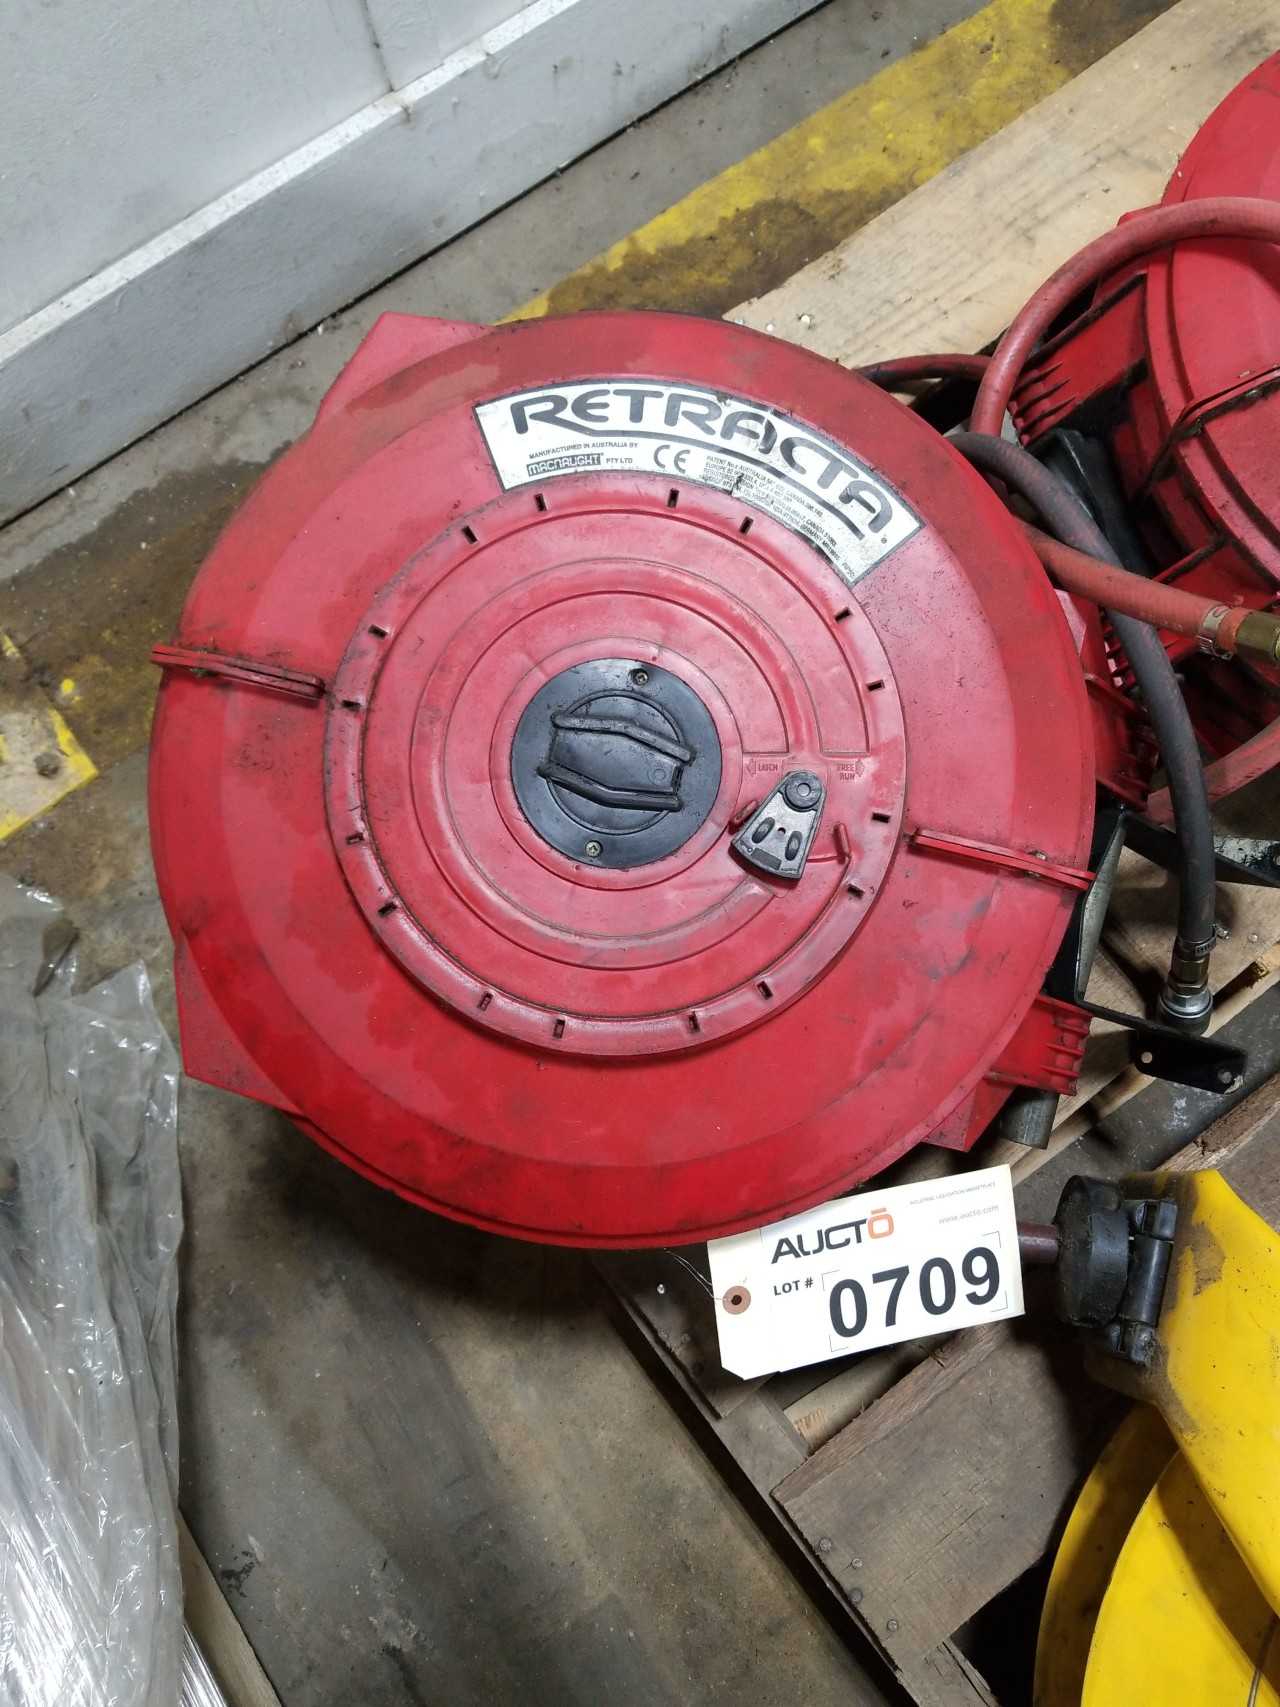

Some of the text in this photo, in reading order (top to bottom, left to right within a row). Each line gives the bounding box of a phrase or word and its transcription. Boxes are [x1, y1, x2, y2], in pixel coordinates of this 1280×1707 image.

[509, 388, 894, 532] RETRACTA
[529, 443, 582, 459] MANUFACTURED
[591, 441, 628, 449] AUSTRALIA
[527, 453, 601, 477] MACNAUGHT
[605, 457, 619, 465] PTY
[773, 1276, 814, 1296] LOT #
[829, 1246, 1000, 1338] 0709
